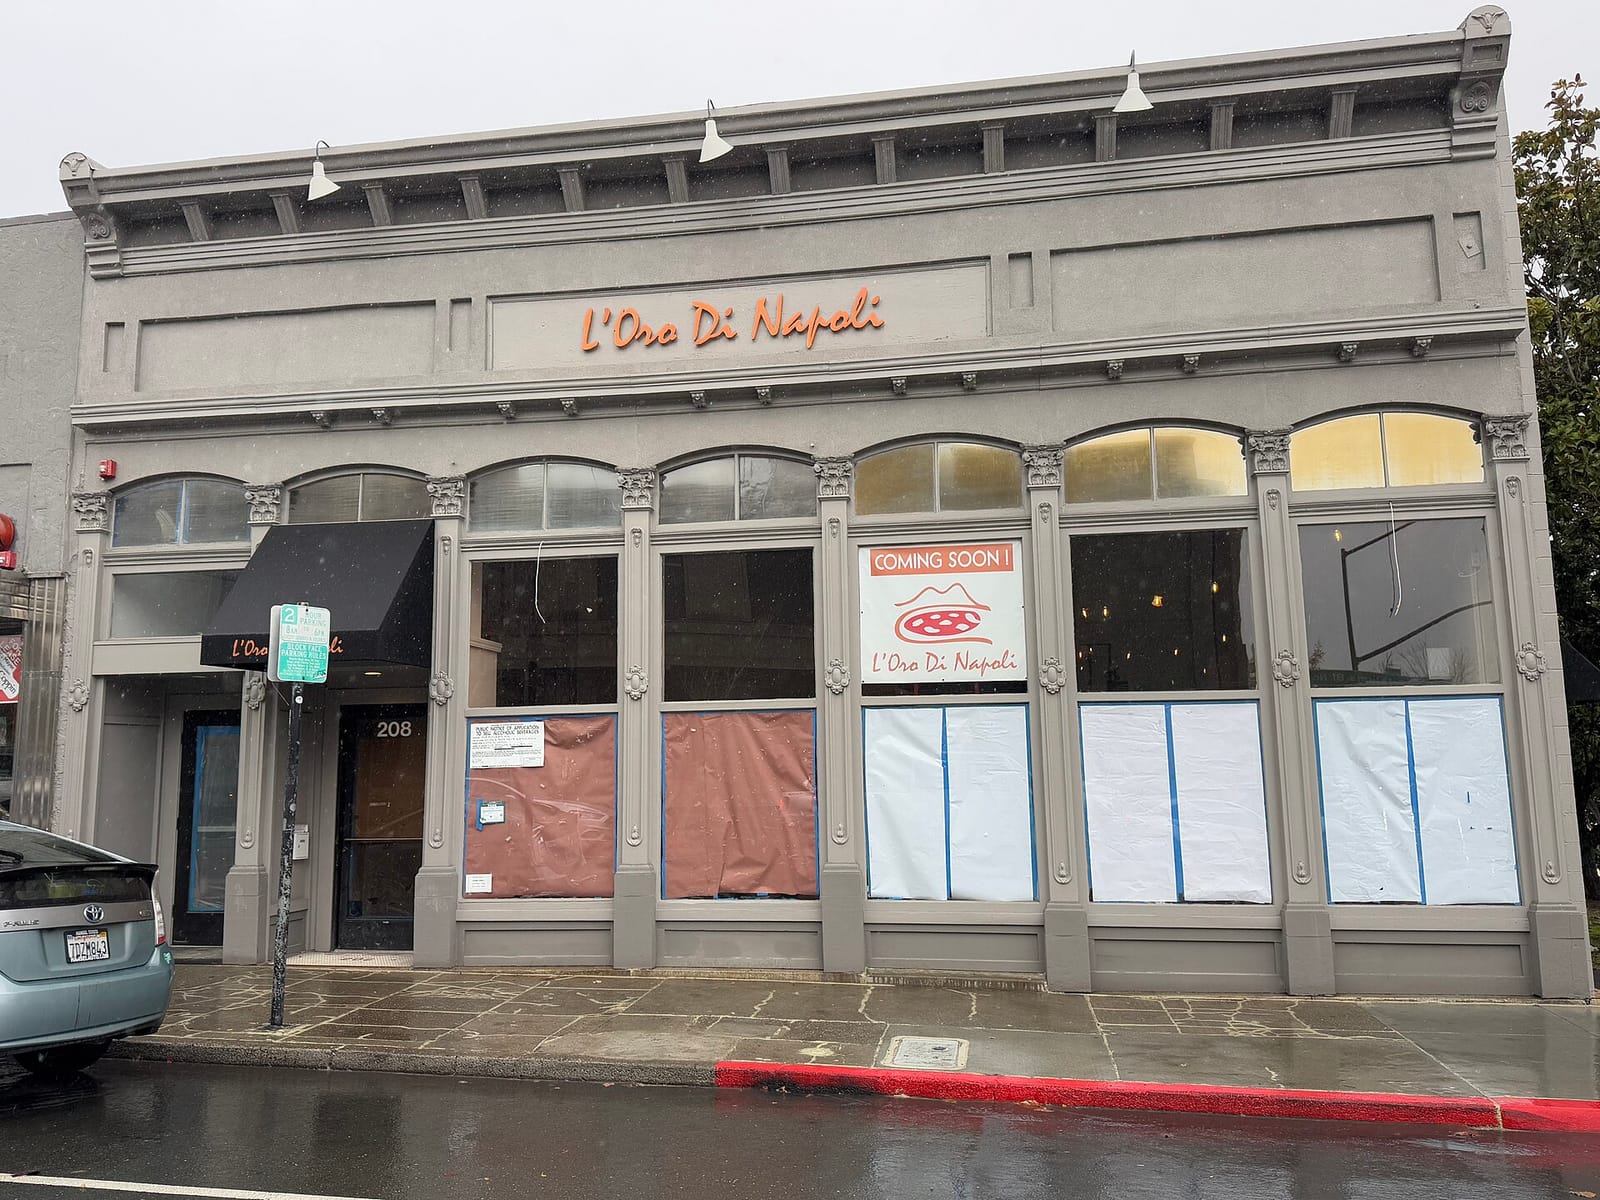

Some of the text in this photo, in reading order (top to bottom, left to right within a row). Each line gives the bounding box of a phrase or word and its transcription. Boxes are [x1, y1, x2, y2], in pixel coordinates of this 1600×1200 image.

[581, 286, 886, 351] L'Oro Di Napoli
[874, 551, 943, 570] COMING
[948, 549, 1000, 568] SOON
[284, 607, 295, 622] 2
[232, 639, 268, 657] L'Oro
[872, 649, 1018, 677] L'Oro Di Napoli
[376, 721, 412, 737] 208
